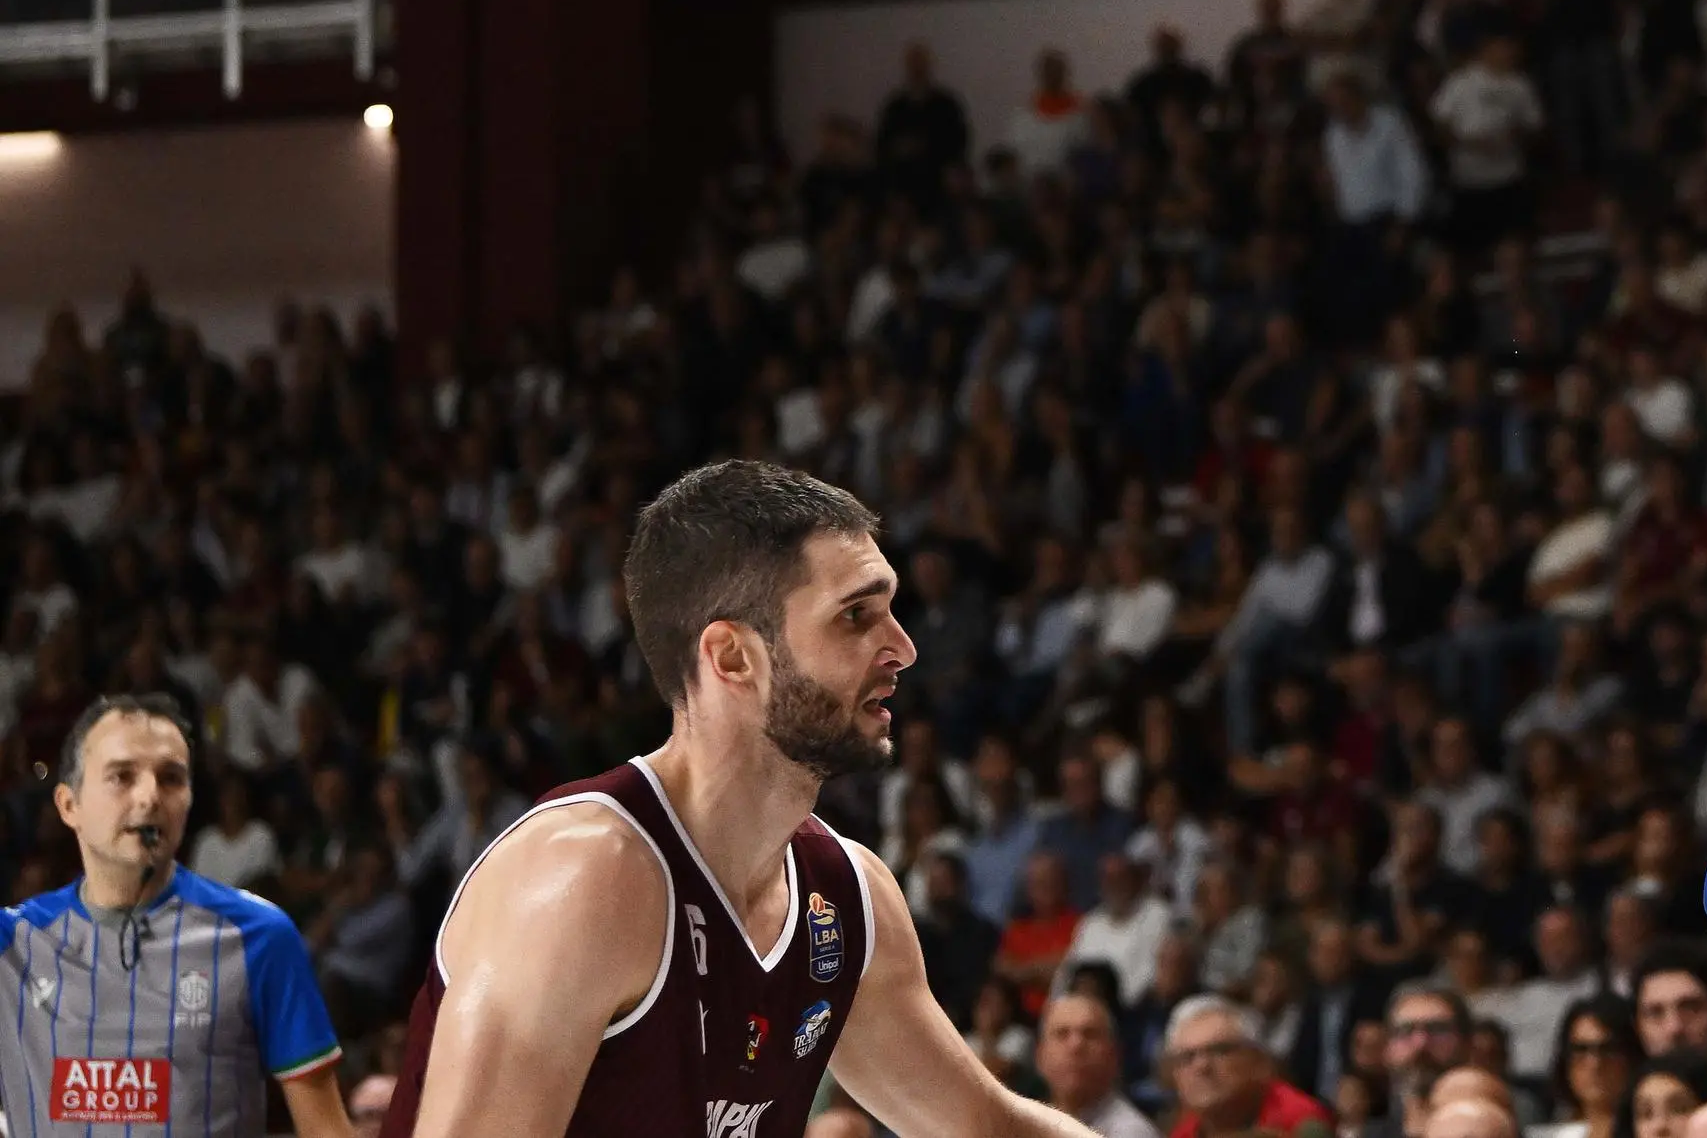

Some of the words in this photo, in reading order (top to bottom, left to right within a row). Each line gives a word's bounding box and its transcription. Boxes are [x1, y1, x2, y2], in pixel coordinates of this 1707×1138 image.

[814, 928, 840, 945] LBA
[818, 957, 839, 971] Unipol
[64, 1060, 158, 1091] ATTAL
[62, 1090, 158, 1110] GROUP
